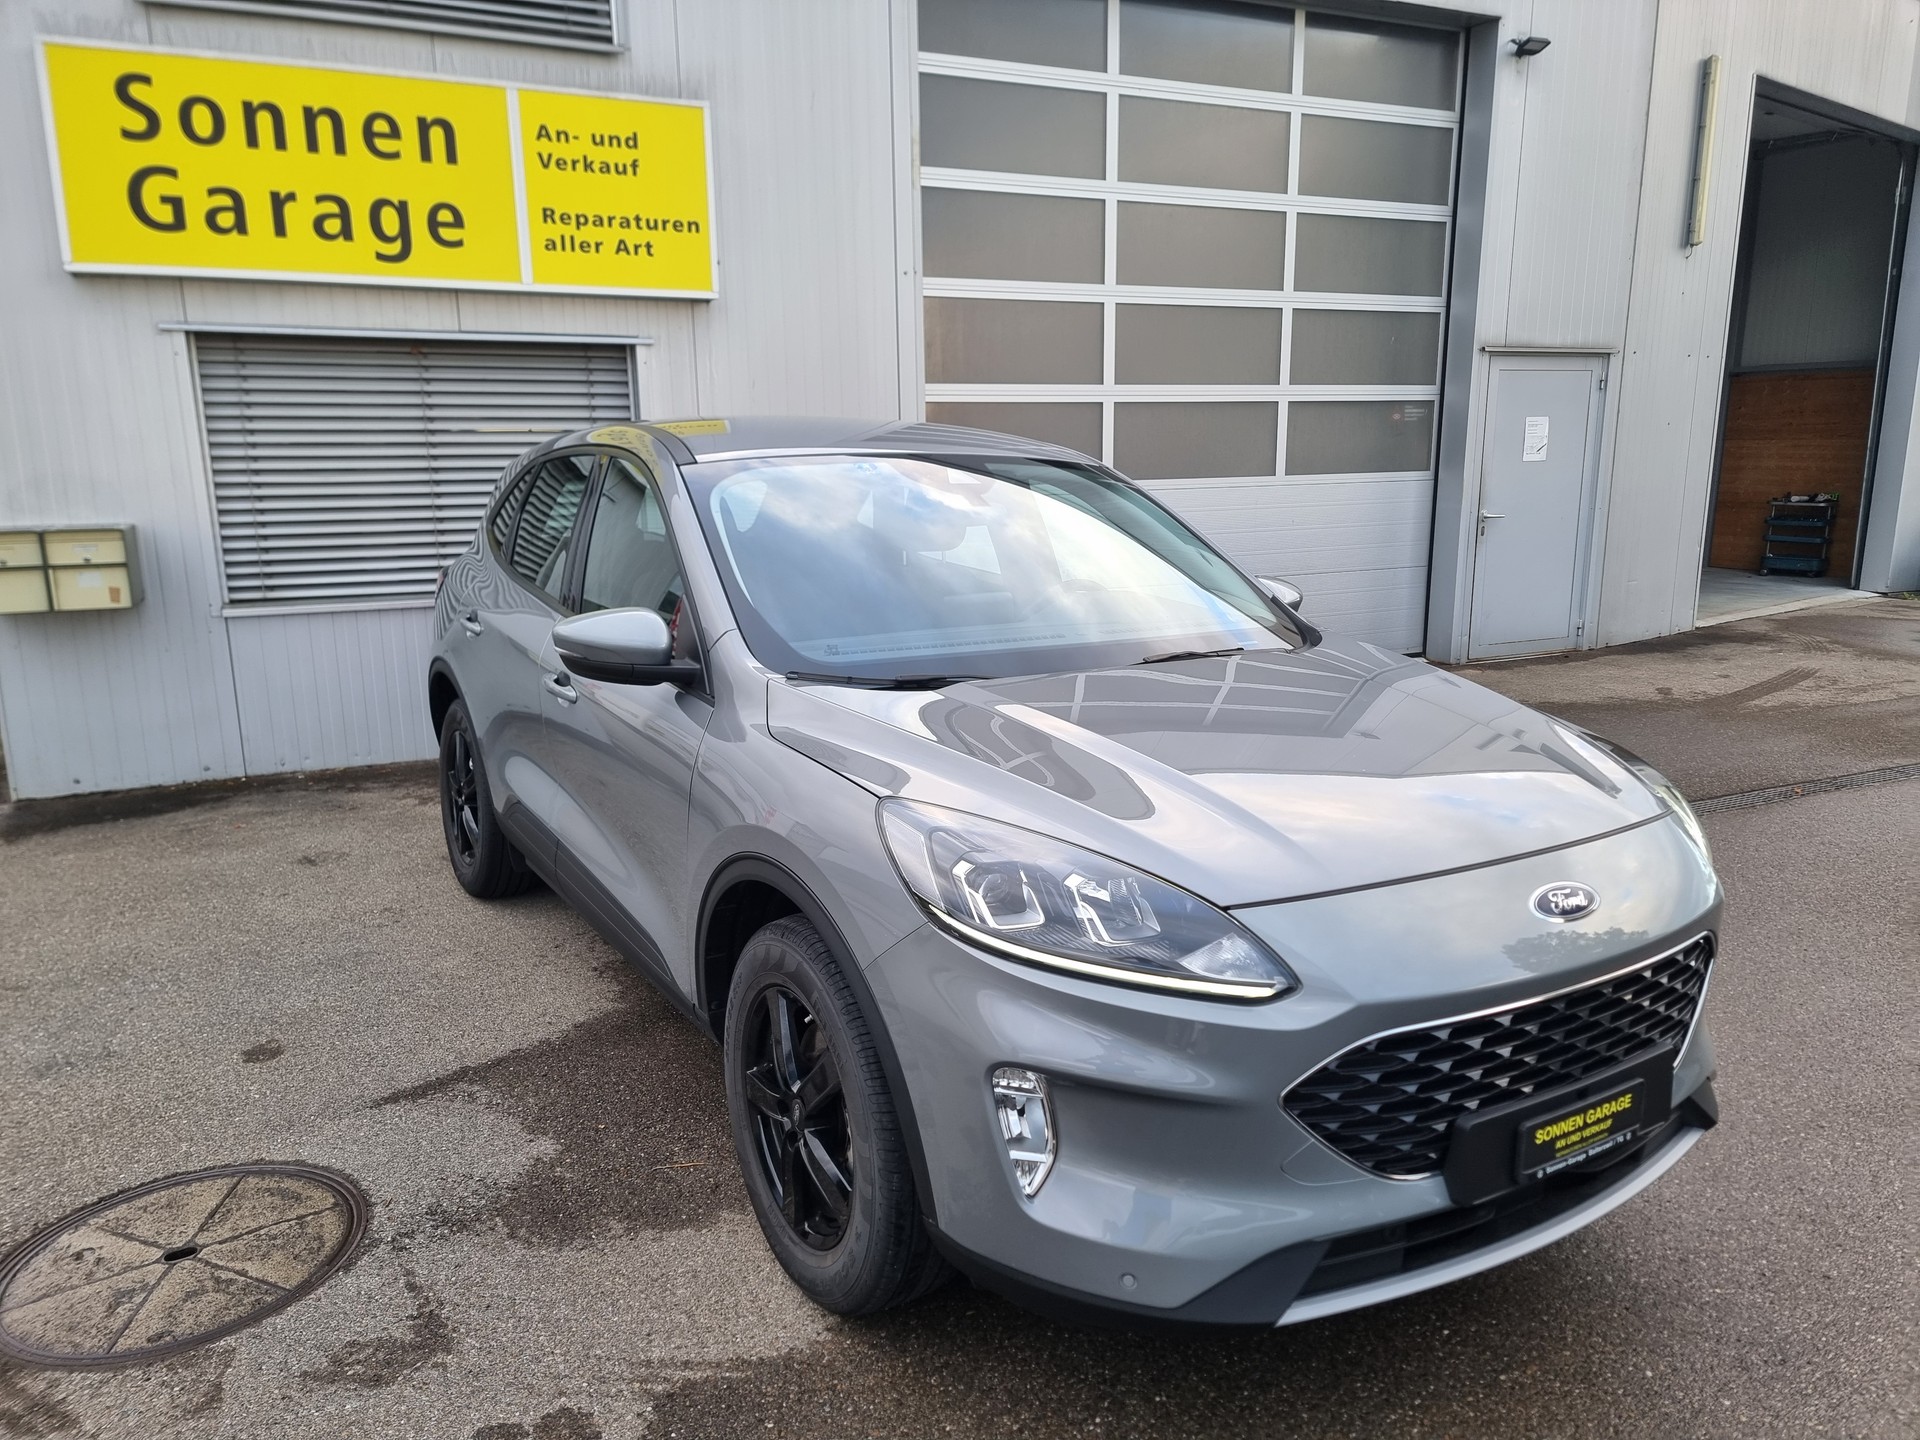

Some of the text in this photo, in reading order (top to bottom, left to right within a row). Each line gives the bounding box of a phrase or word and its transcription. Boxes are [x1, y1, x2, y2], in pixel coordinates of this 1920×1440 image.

[115, 72, 458, 166] Sonnen
[537, 124, 638, 150] An- und
[537, 152, 639, 176] Verkauf
[127, 165, 465, 264] Garage
[542, 207, 700, 233] Reparaturen
[544, 234, 653, 257] aller Art
[1547, 887, 1588, 914] Ford
[1535, 1114, 1584, 1145] SONNEN
[1586, 1093, 1633, 1124] GARAGE
[1555, 1135, 1566, 1149] AN
[1567, 1131, 1581, 1145] UND
[1582, 1118, 1613, 1138] VERKAUF
